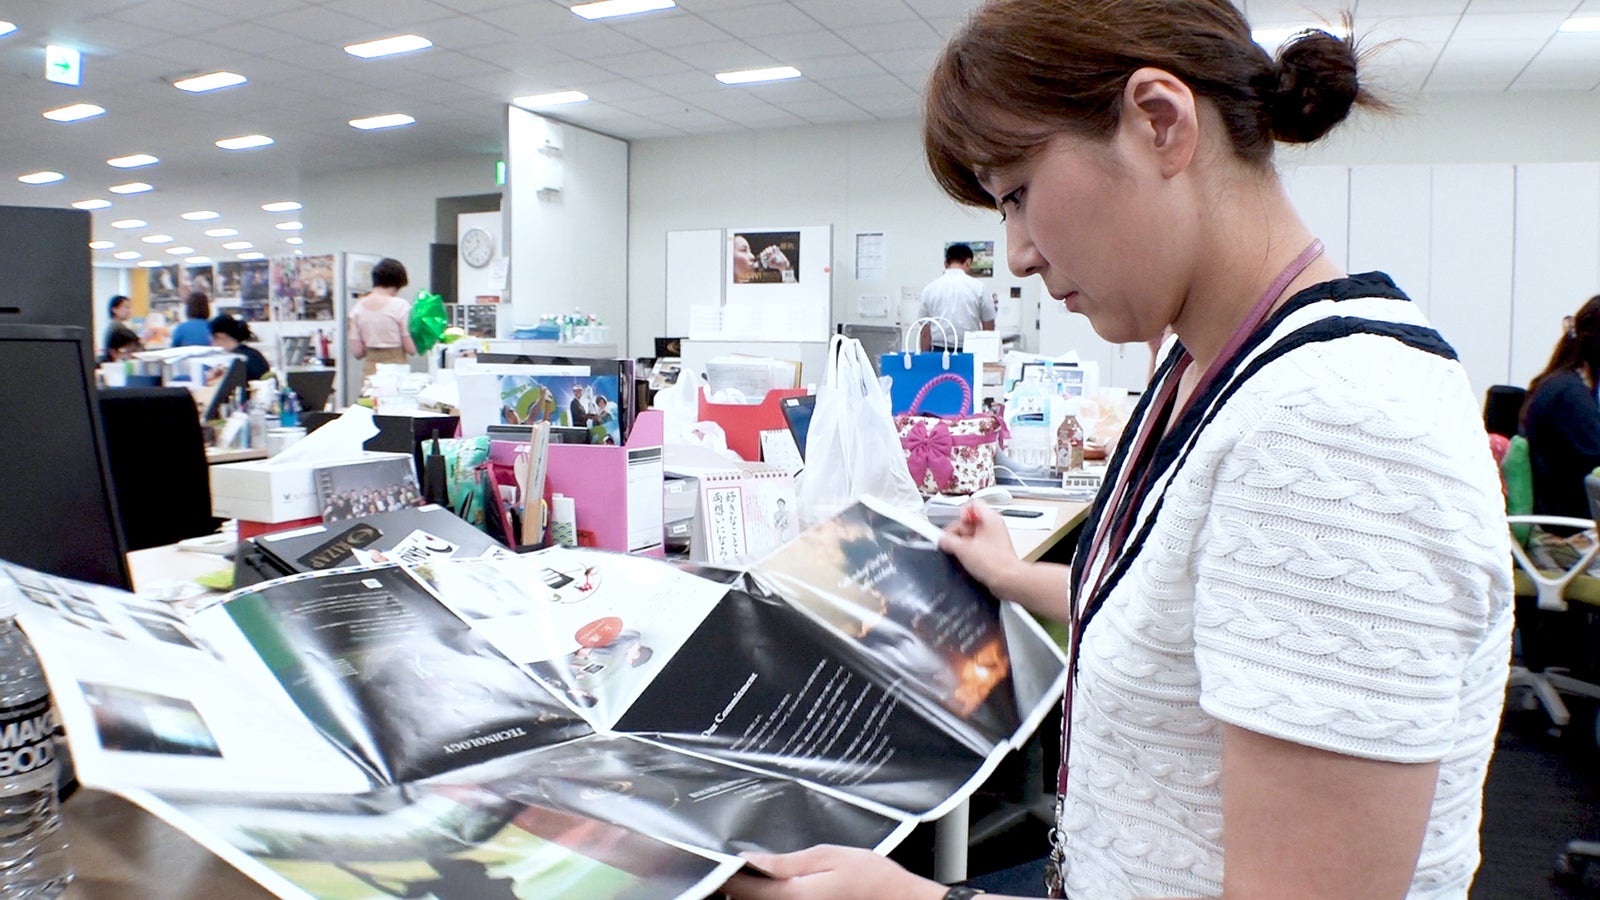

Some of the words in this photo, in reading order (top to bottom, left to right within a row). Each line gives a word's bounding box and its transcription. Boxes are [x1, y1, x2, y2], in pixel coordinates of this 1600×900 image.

[700, 722, 719, 739] Our
[715, 672, 758, 723] Commitment
[0, 739, 57, 776] BOD
[443, 726, 528, 754] TECHNOLOGY
